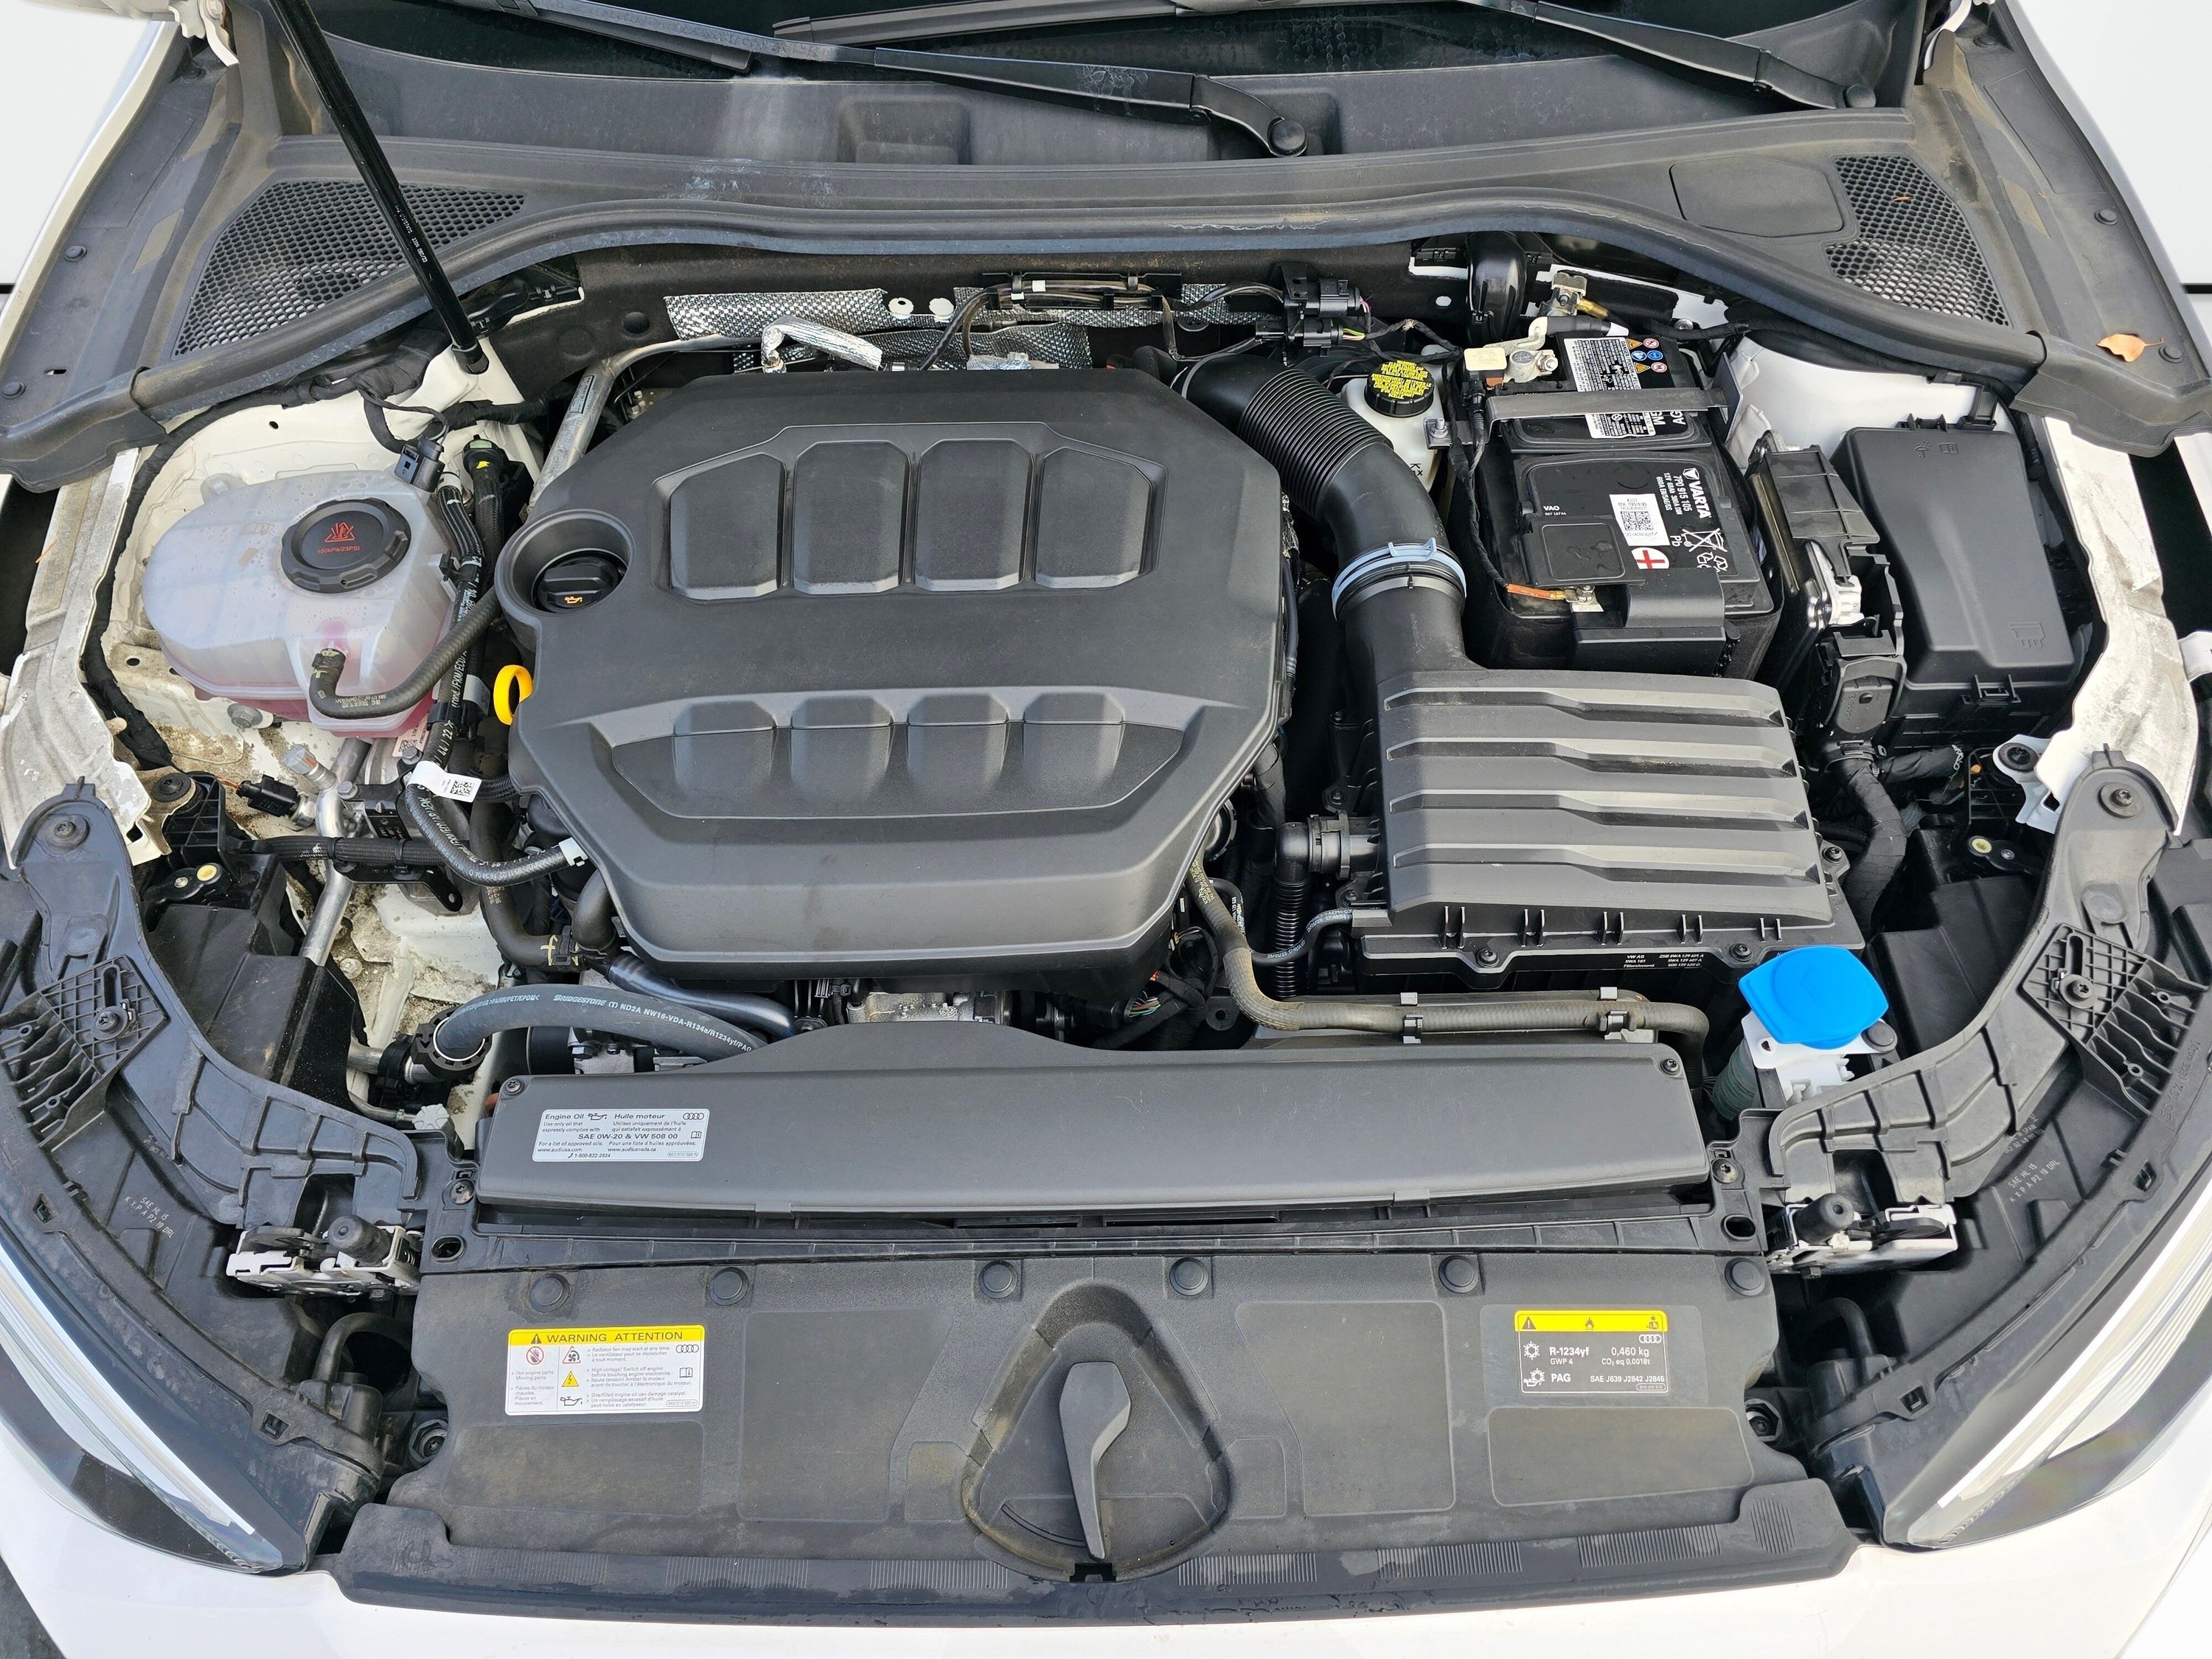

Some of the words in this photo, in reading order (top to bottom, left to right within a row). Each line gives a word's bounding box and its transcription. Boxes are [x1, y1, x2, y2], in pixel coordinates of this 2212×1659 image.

[1677, 487, 1688, 498] 915
[1682, 498, 1692, 512] 105
[1689, 481, 1711, 518] VARTA
[1670, 535, 1683, 547] Pb
[318, 546, 360, 554] 160kPa/23PSI
[554, 995, 607, 1006] BRIDGESTONE
[620, 1004, 641, 1014] ND2A
[2031, 1175, 2042, 1183] P2
[2046, 1160, 2060, 1170] DRL
[2008, 1176, 2022, 1188] SAE
[140, 1197, 154, 1208] SAE
[153, 1207, 161, 1215] HL
[147, 1214, 156, 1223] P2
[162, 1226, 175, 1239] DRL
[547, 1333, 607, 1343] WARNING
[615, 1332, 683, 1341] ATTENTION
[1549, 1347, 1590, 1357] R-1234yf
[1611, 1347, 1636, 1357] 0,460
[1639, 1346, 1649, 1357] kg
[1551, 1374, 1571, 1382] PAG
